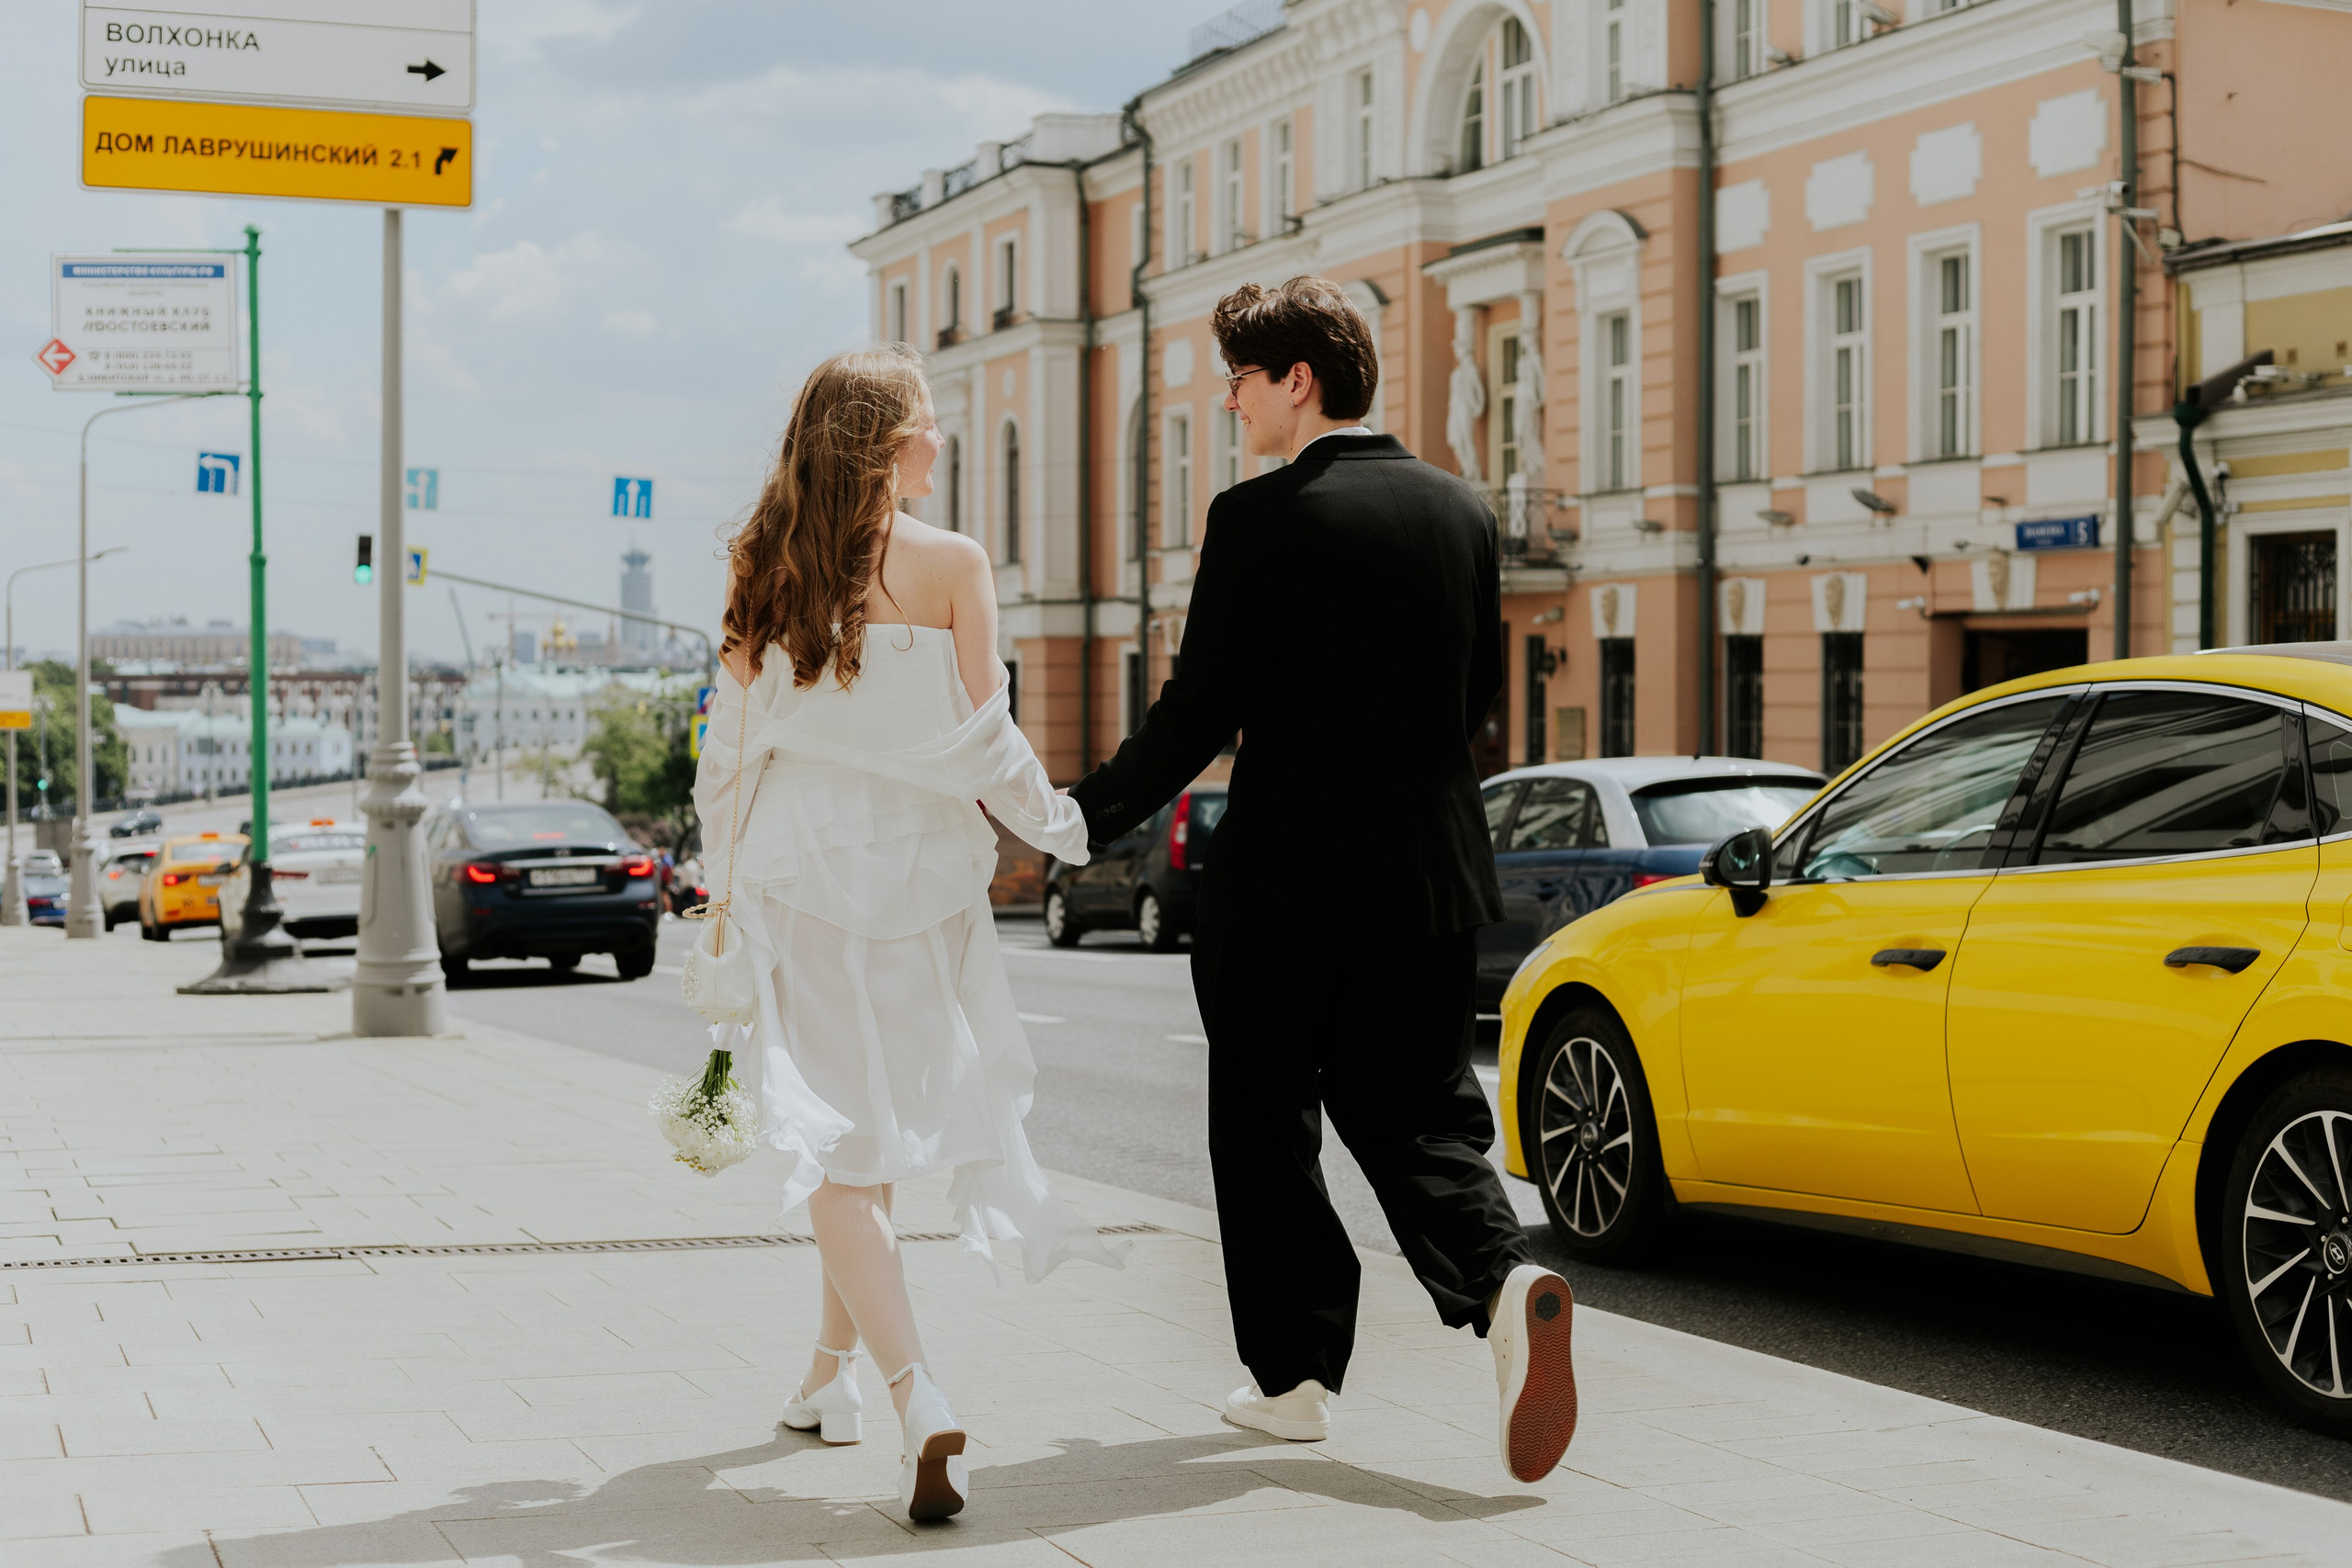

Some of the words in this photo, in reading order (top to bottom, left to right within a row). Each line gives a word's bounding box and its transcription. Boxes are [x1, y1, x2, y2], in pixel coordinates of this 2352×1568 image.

[107, 22, 261, 51] ВОЛХОНКА
[104, 57, 187, 78] улица
[95, 131, 154, 154] ДОМ
[164, 135, 379, 167] ЛАВРУШИНСКИЙ
[389, 149, 423, 169] 2.1
